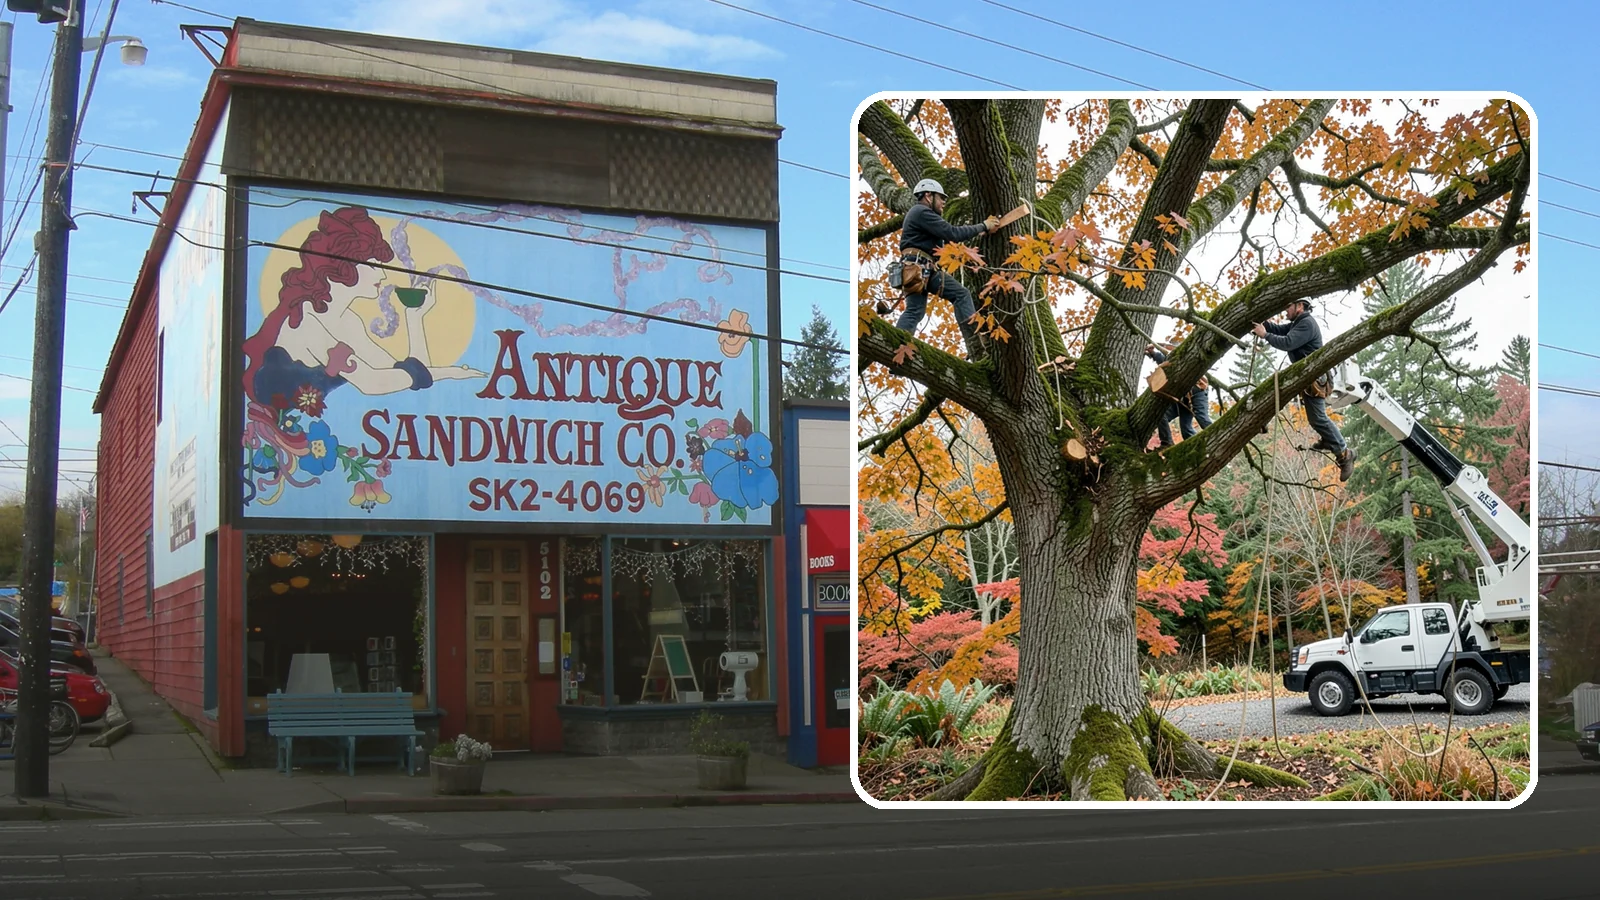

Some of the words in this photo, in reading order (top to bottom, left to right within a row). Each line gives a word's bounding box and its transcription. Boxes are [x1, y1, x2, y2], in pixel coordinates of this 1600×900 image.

[476, 329, 724, 421] ANTIQUE
[361, 408, 604, 467] SANDWICH
[617, 422, 685, 468] CO.
[468, 477, 646, 514] SK2-4069
[540, 541, 551, 600] 5102
[809, 555, 834, 568] BOOKS
